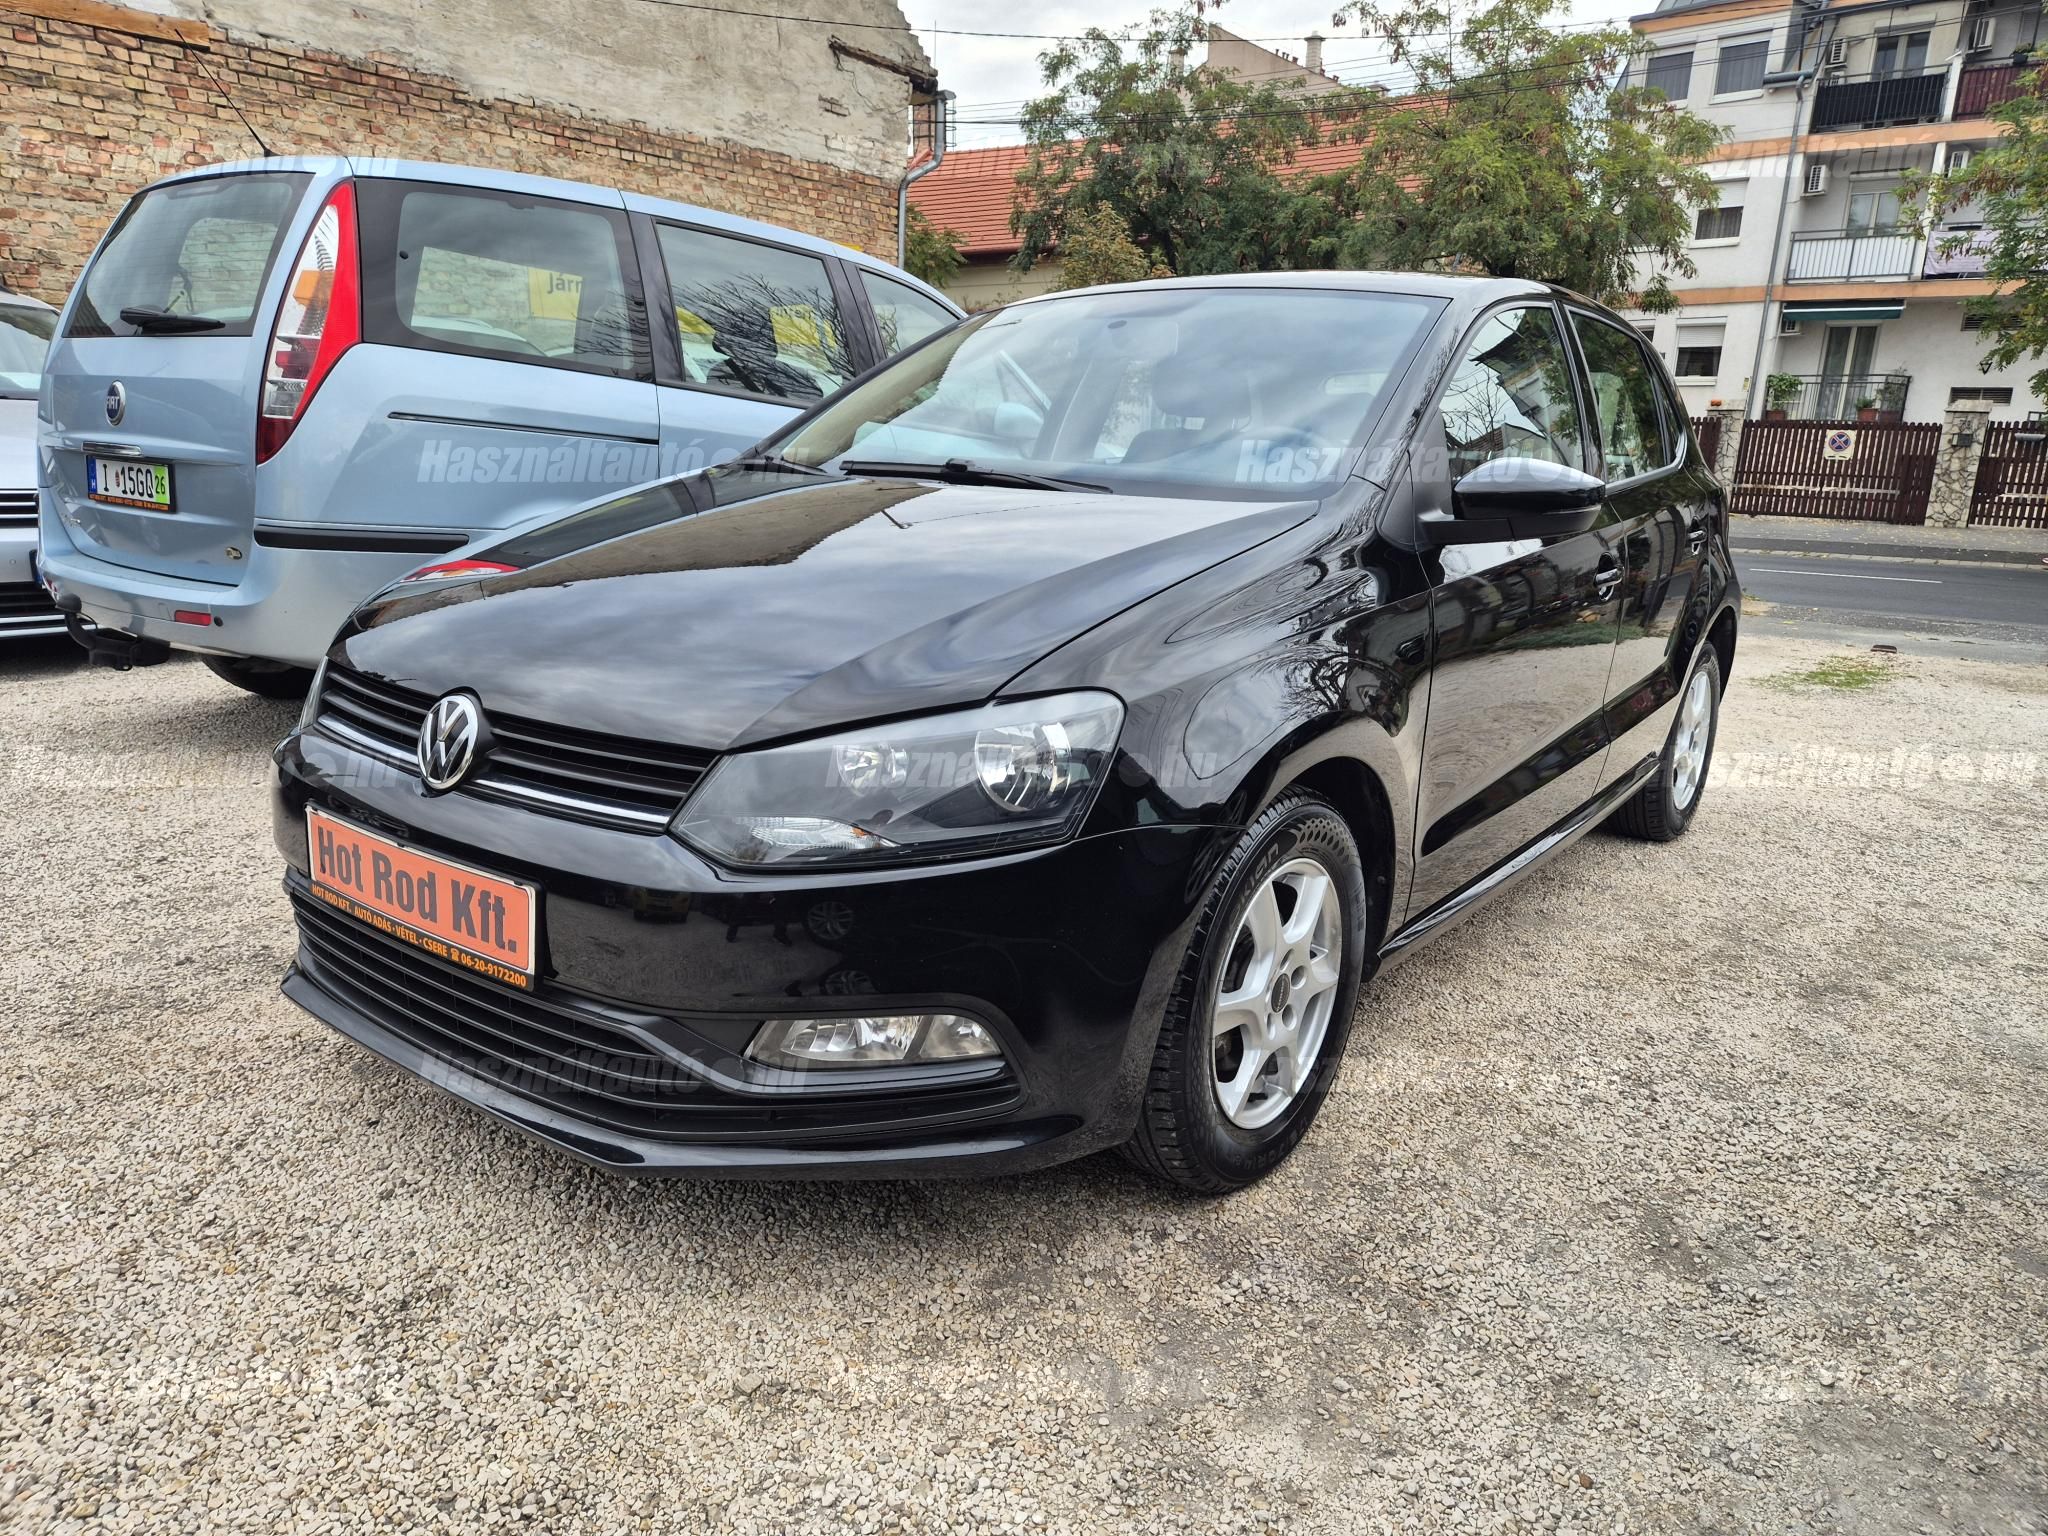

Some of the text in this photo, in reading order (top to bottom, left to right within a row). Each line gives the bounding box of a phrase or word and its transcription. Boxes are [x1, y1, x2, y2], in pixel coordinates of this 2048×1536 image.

[155, 475, 166, 495] 26
[312, 884, 325, 899] HOT
[325, 890, 338, 907] ROD
[339, 897, 351, 912] KFT.
[354, 906, 372, 922] AUTÓ
[423, 937, 448, 957] CSERE
[461, 953, 527, 987] 06-20-9172200
[318, 826, 516, 953] Hot Rod Kft.
